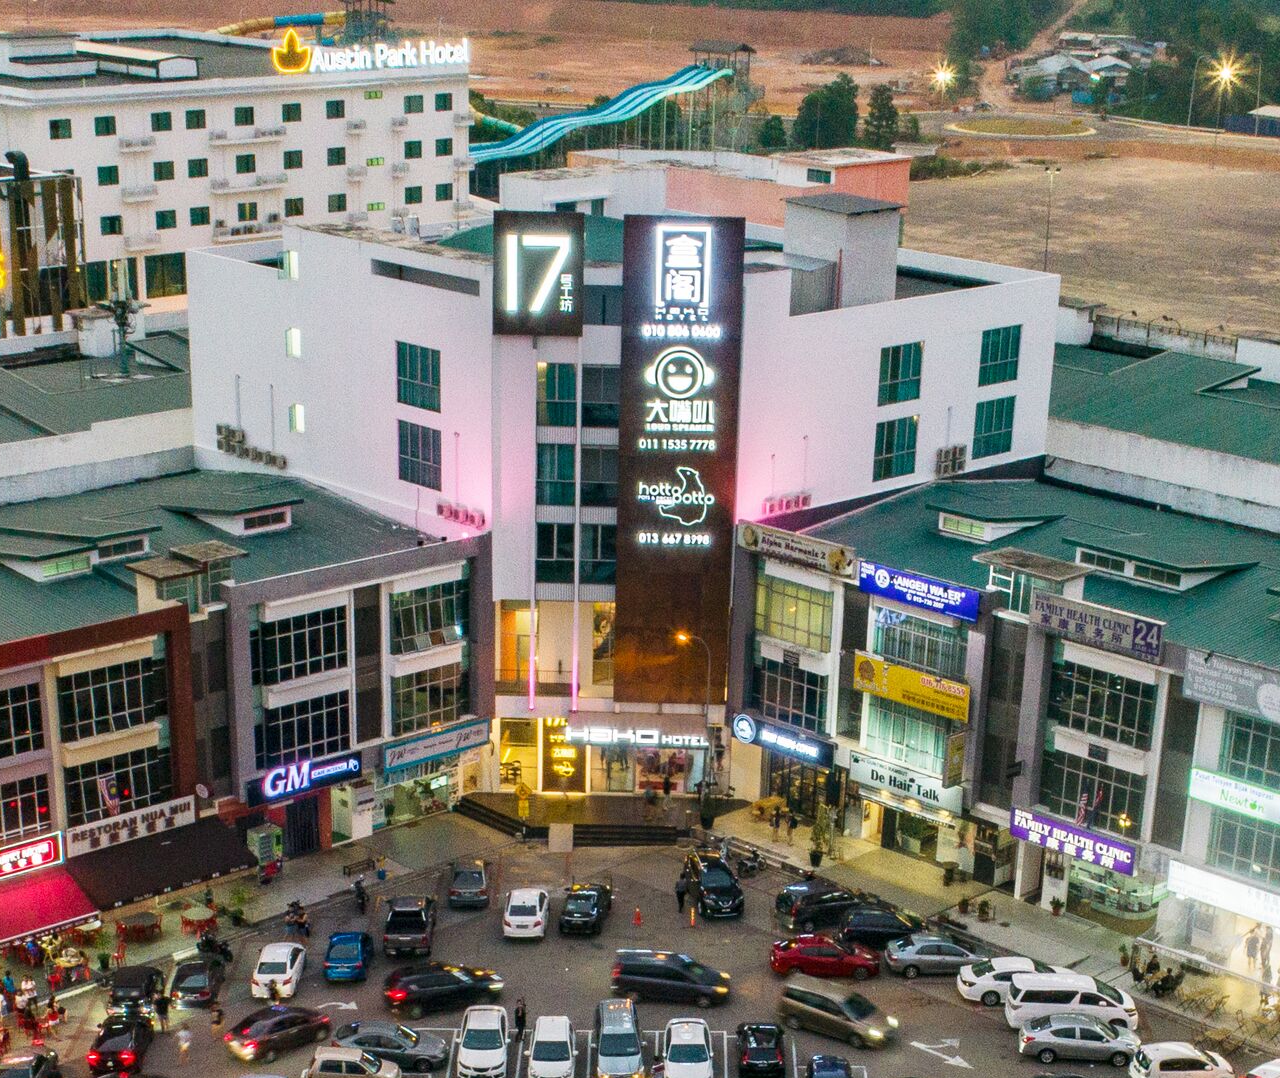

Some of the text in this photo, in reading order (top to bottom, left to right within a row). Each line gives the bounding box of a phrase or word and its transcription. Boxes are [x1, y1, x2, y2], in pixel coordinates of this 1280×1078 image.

[310, 37, 470, 73] Austin Park Hotel
[506, 234, 573, 312] 17 号工坊
[642, 324, 666, 337] 010
[639, 438, 658, 450] 011
[662, 439, 687, 450] 1535
[639, 482, 682, 496] hotto
[639, 532, 659, 544] 013
[761, 535, 783, 550] Alpha
[784, 540, 820, 559] Harmonic
[1035, 600, 1159, 647] FAMILY HEALTH CLINIC 24
[661, 735, 710, 746] HOTEL
[264, 760, 312, 798] GM
[870, 768, 940, 802] De Hair Talk
[72, 815, 138, 844] RESTORAN
[168, 801, 191, 816] MUI
[1014, 816, 1132, 864] FAMILY HEALTH CLINIC
[1028, 831, 1115, 869] 家康医务所
